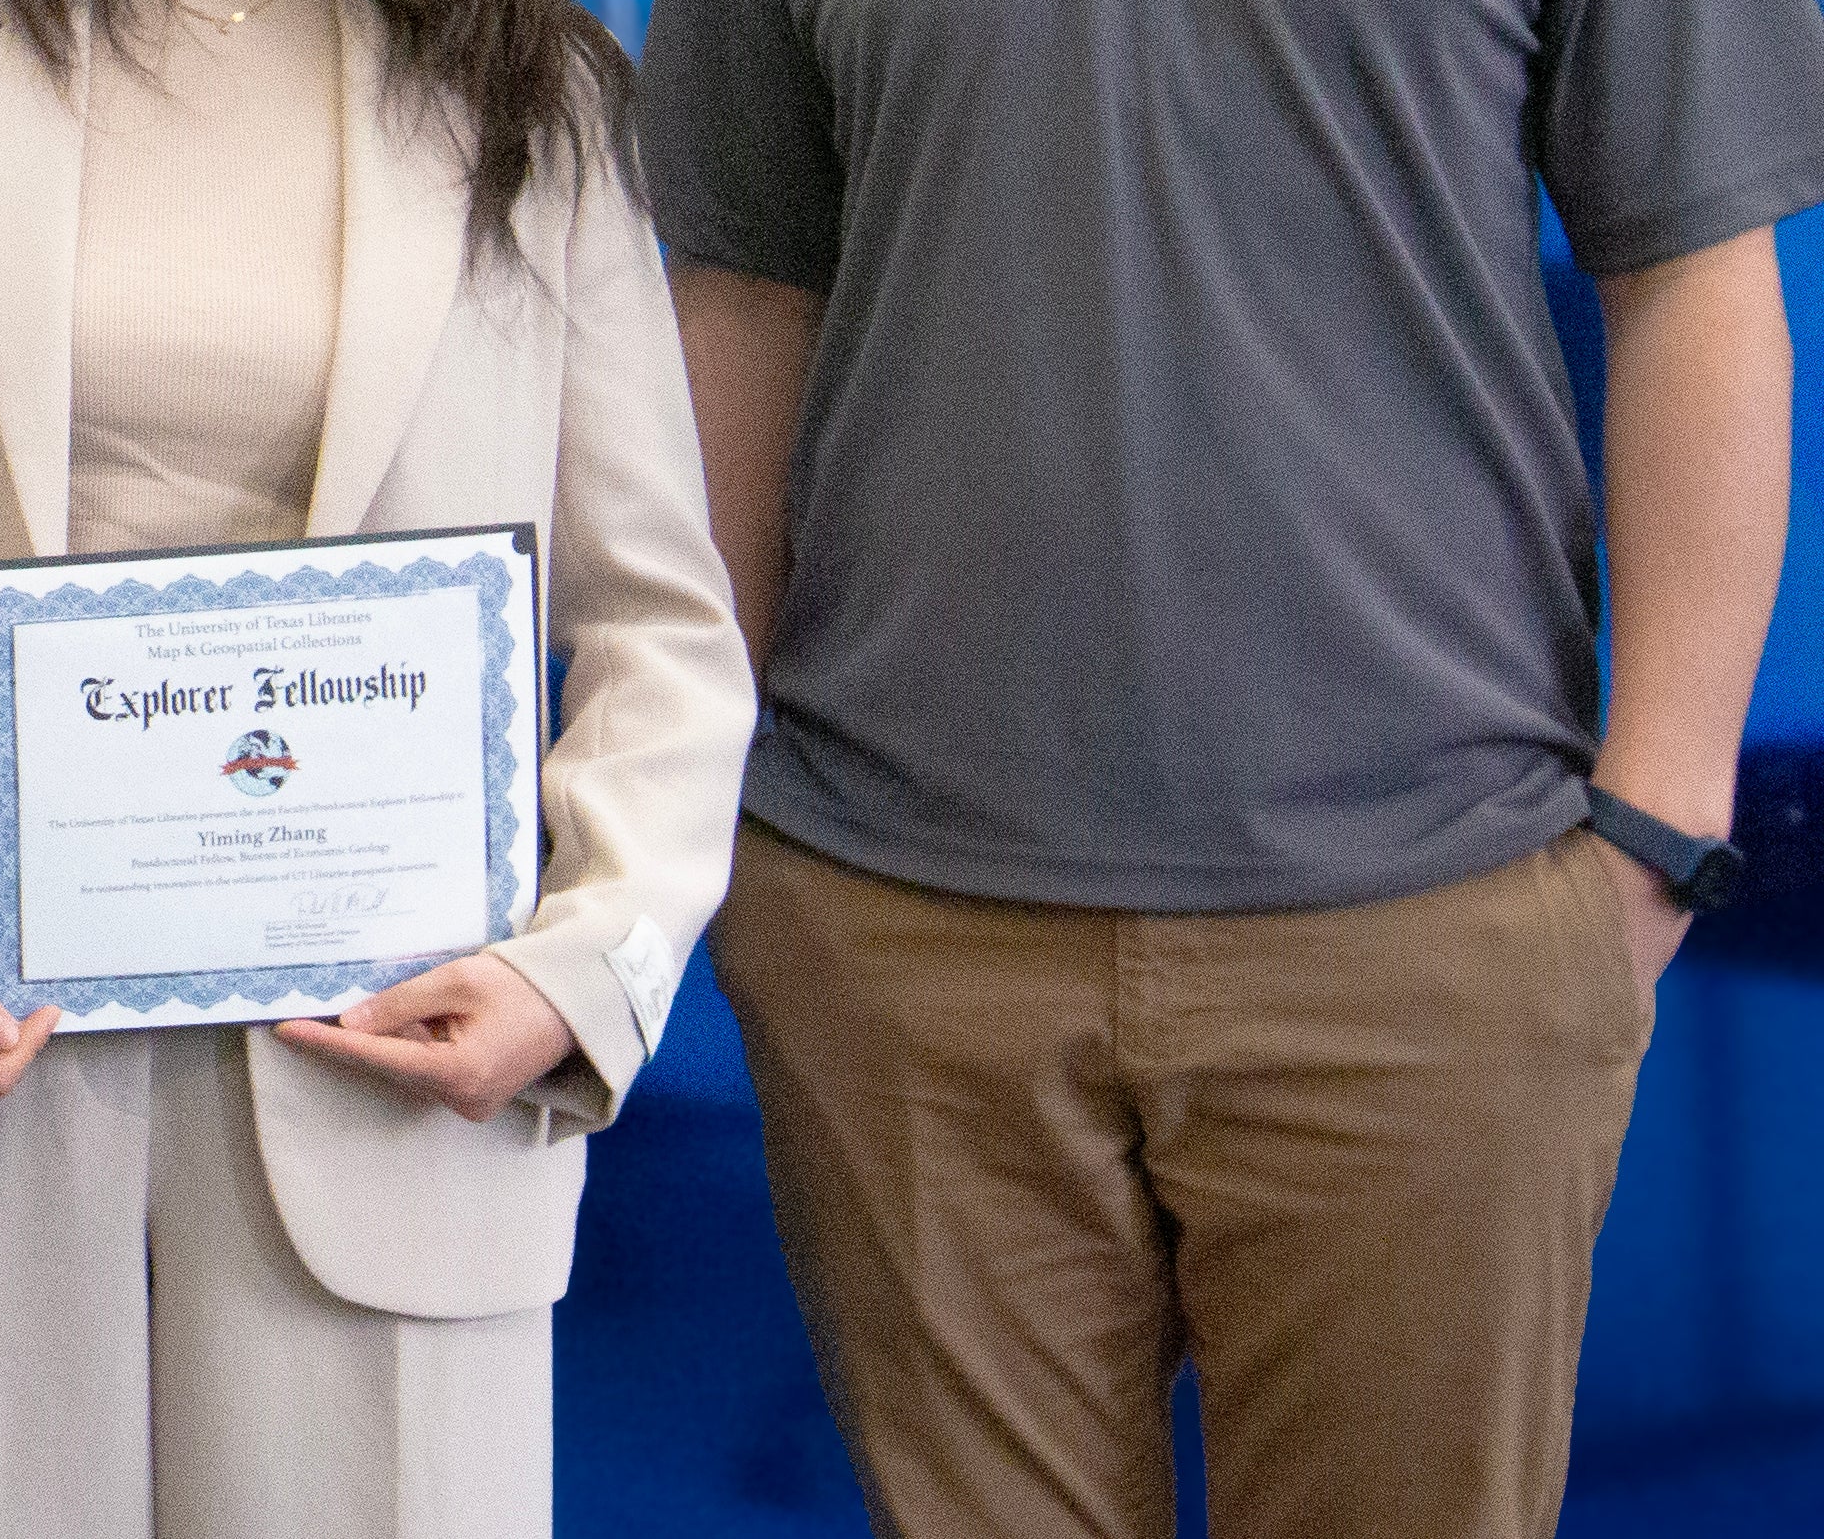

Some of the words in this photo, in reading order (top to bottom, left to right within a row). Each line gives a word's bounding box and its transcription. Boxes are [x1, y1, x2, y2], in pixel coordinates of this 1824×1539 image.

[135, 622, 165, 638] The
[169, 619, 241, 637] University
[245, 617, 260, 631] of
[263, 615, 304, 629] Texas
[308, 611, 373, 627] Libraries
[147, 644, 181, 661] Map
[183, 643, 196, 657] &
[200, 638, 278, 659] Geospatial
[281, 632, 362, 650] Collections
[80, 675, 234, 731] Explorer
[253, 661, 427, 713] Fellowship
[197, 829, 264, 849] Yiming
[268, 825, 328, 844] Zhang
